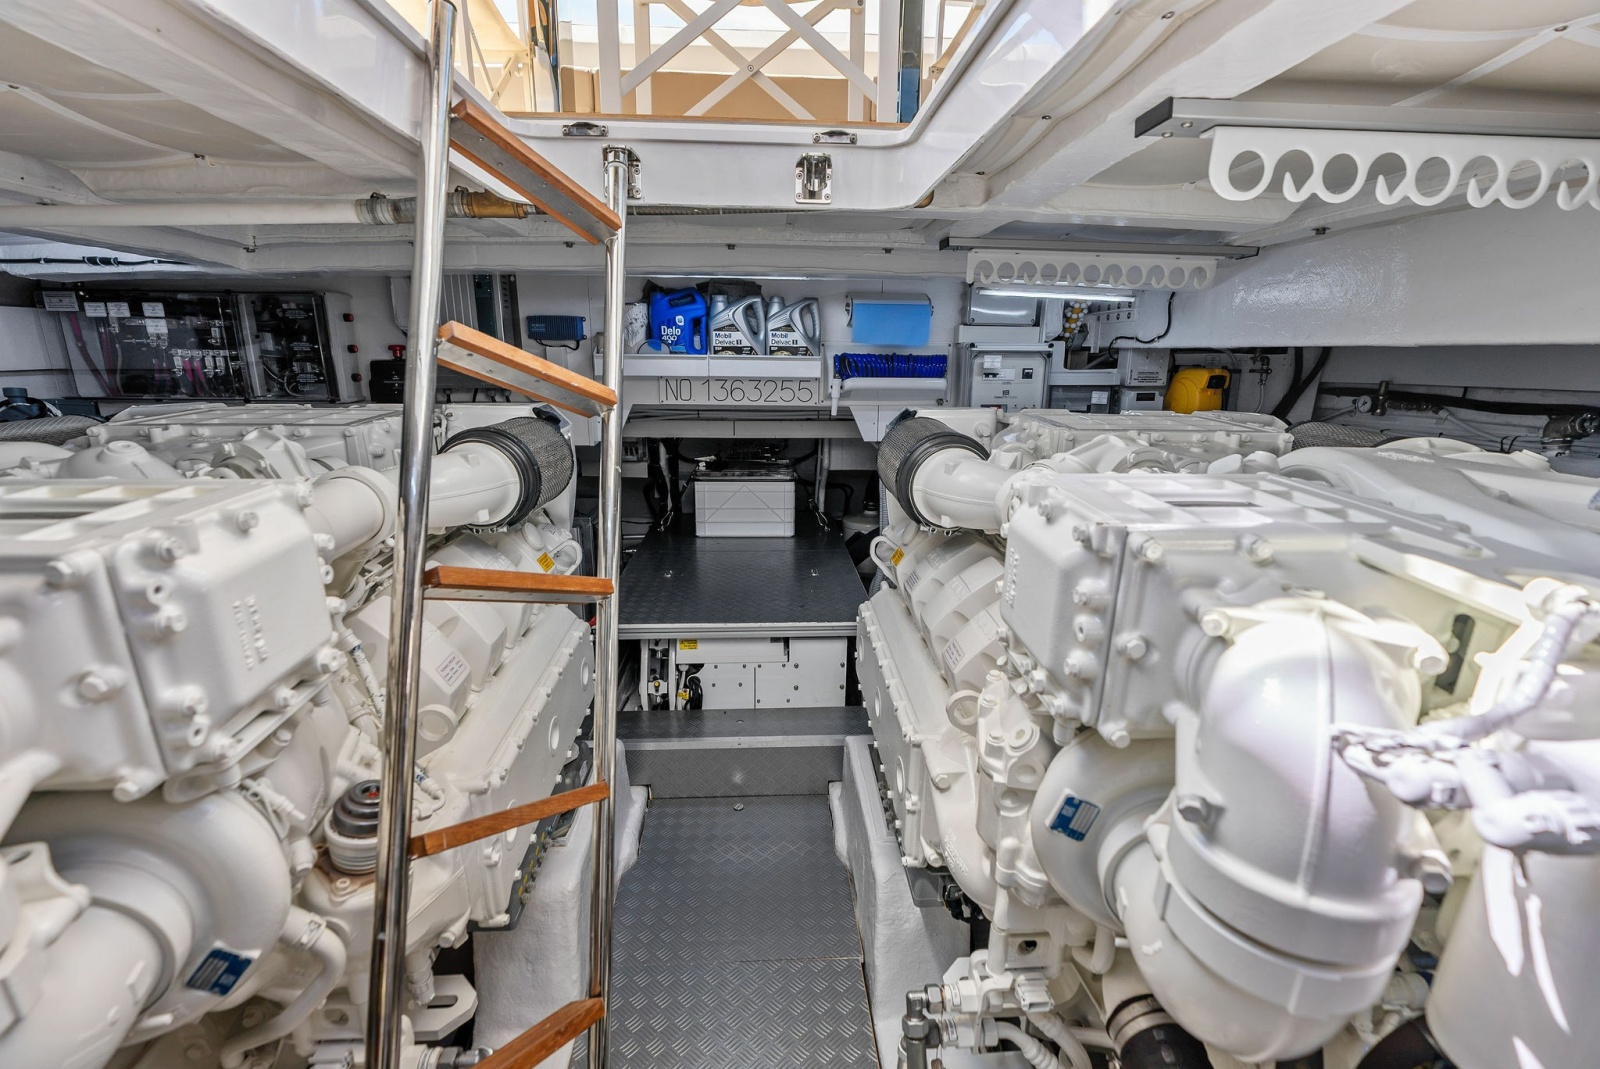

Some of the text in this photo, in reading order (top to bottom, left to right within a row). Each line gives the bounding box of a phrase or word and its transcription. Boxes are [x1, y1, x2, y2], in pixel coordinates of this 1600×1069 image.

[661, 325, 681, 336] Delo
[665, 378, 813, 403] NO. 1363255
